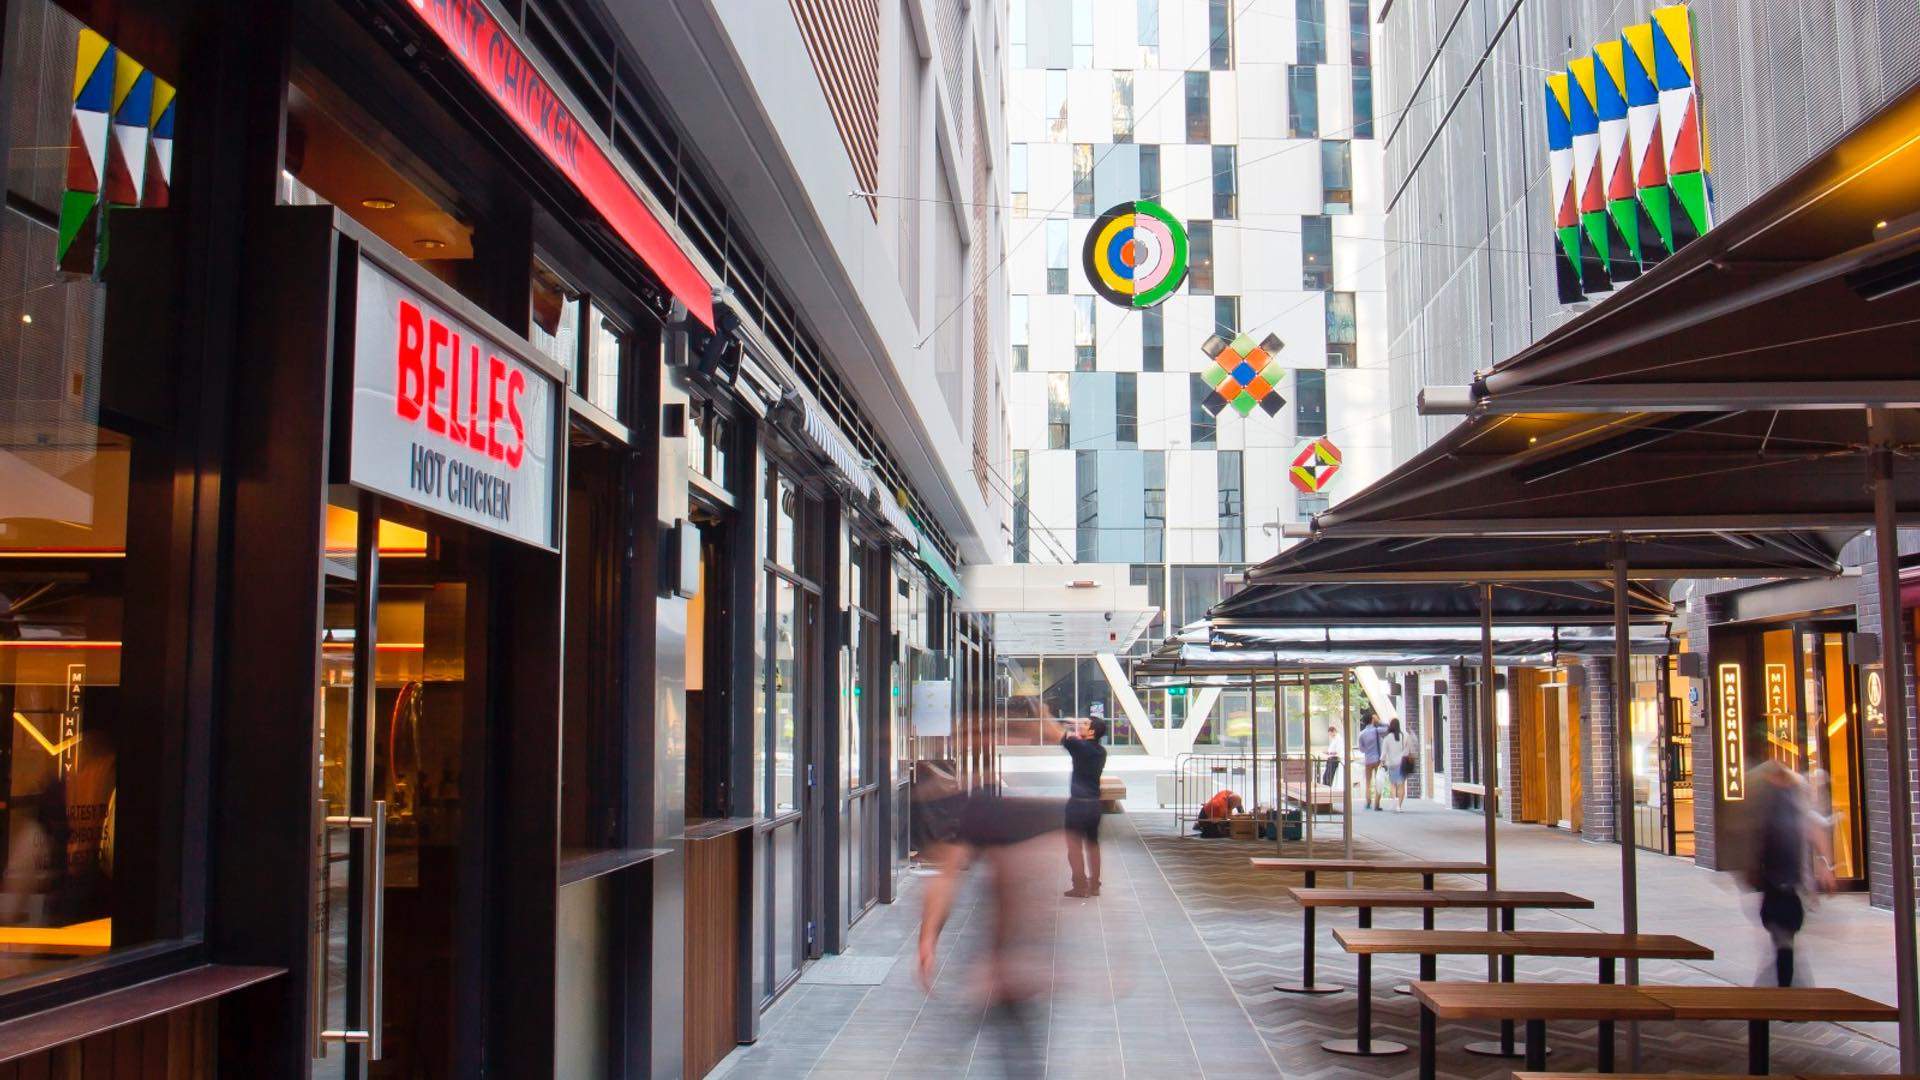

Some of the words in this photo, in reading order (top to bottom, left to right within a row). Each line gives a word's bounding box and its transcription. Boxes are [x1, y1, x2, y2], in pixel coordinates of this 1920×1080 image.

[488, 31, 578, 170] CHICKEN
[396, 299, 527, 470] BELLES
[411, 442, 446, 498] HOT
[448, 458, 513, 523] CHICKEN
[1724, 672, 1740, 792] MATCHAIYA
